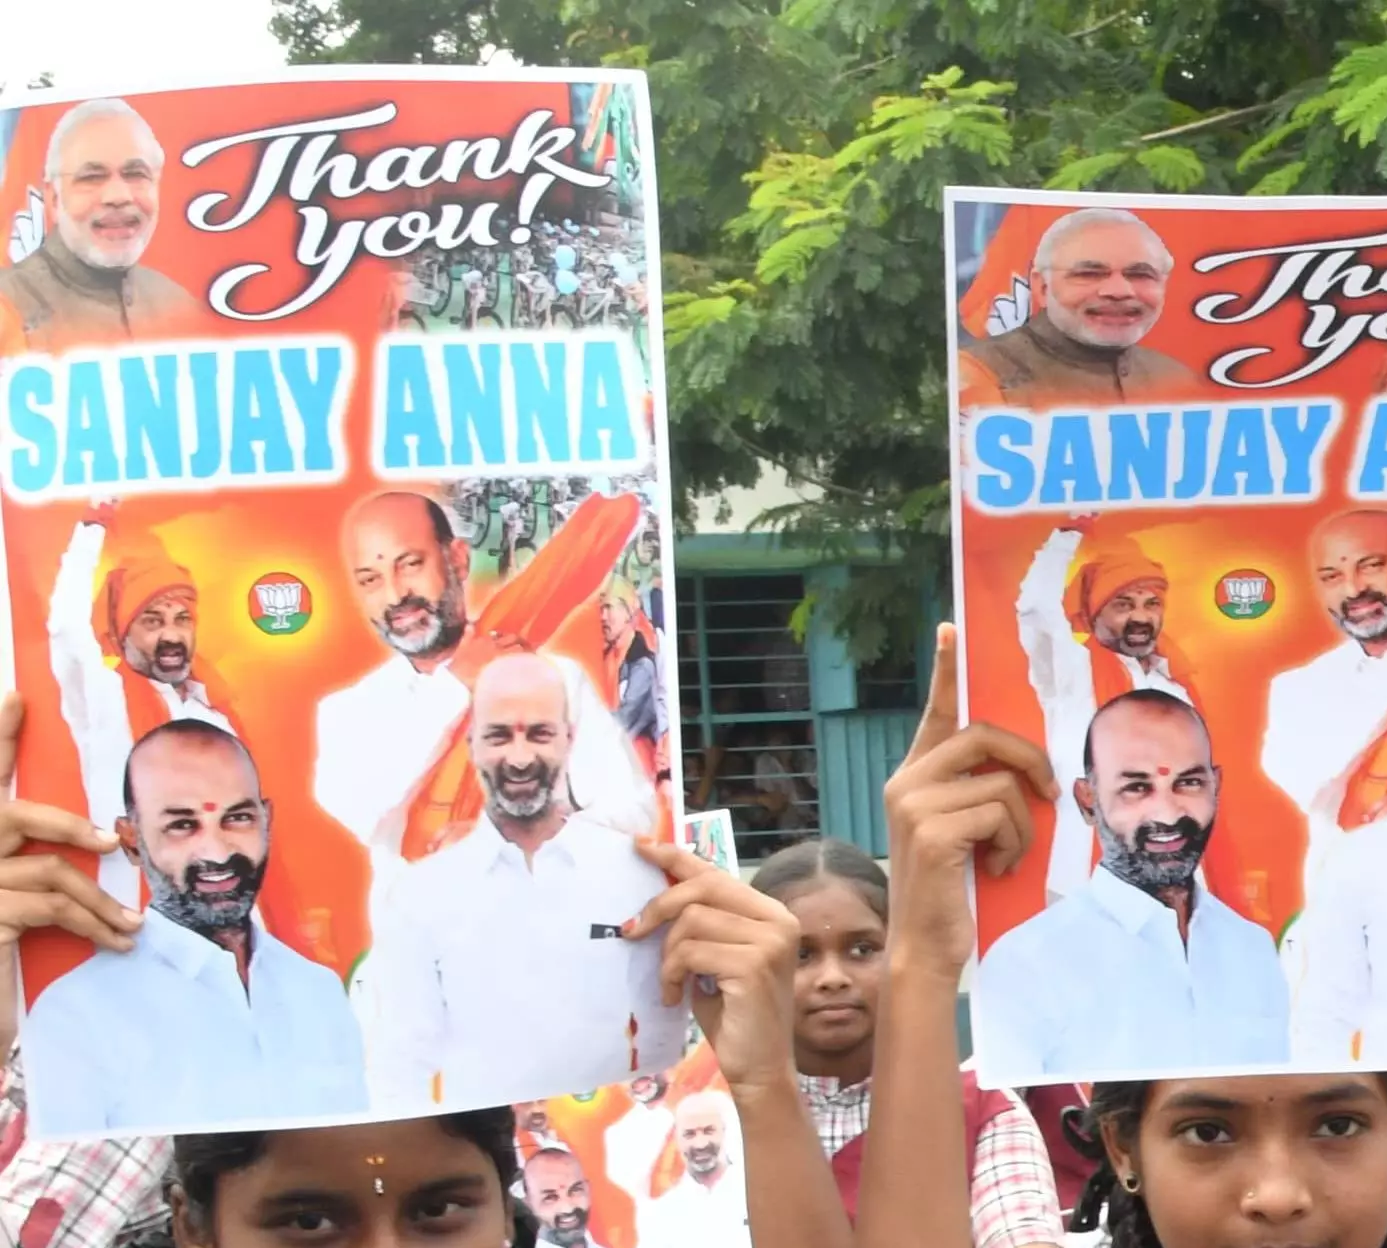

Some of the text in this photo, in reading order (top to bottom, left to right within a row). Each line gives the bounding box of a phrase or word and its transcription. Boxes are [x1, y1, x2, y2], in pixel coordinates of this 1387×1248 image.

[182, 102, 610, 231] Thank
[209, 173, 554, 321] you!
[8, 341, 637, 492] SANJAY ANNA
[973, 404, 1335, 508] SANJAY
